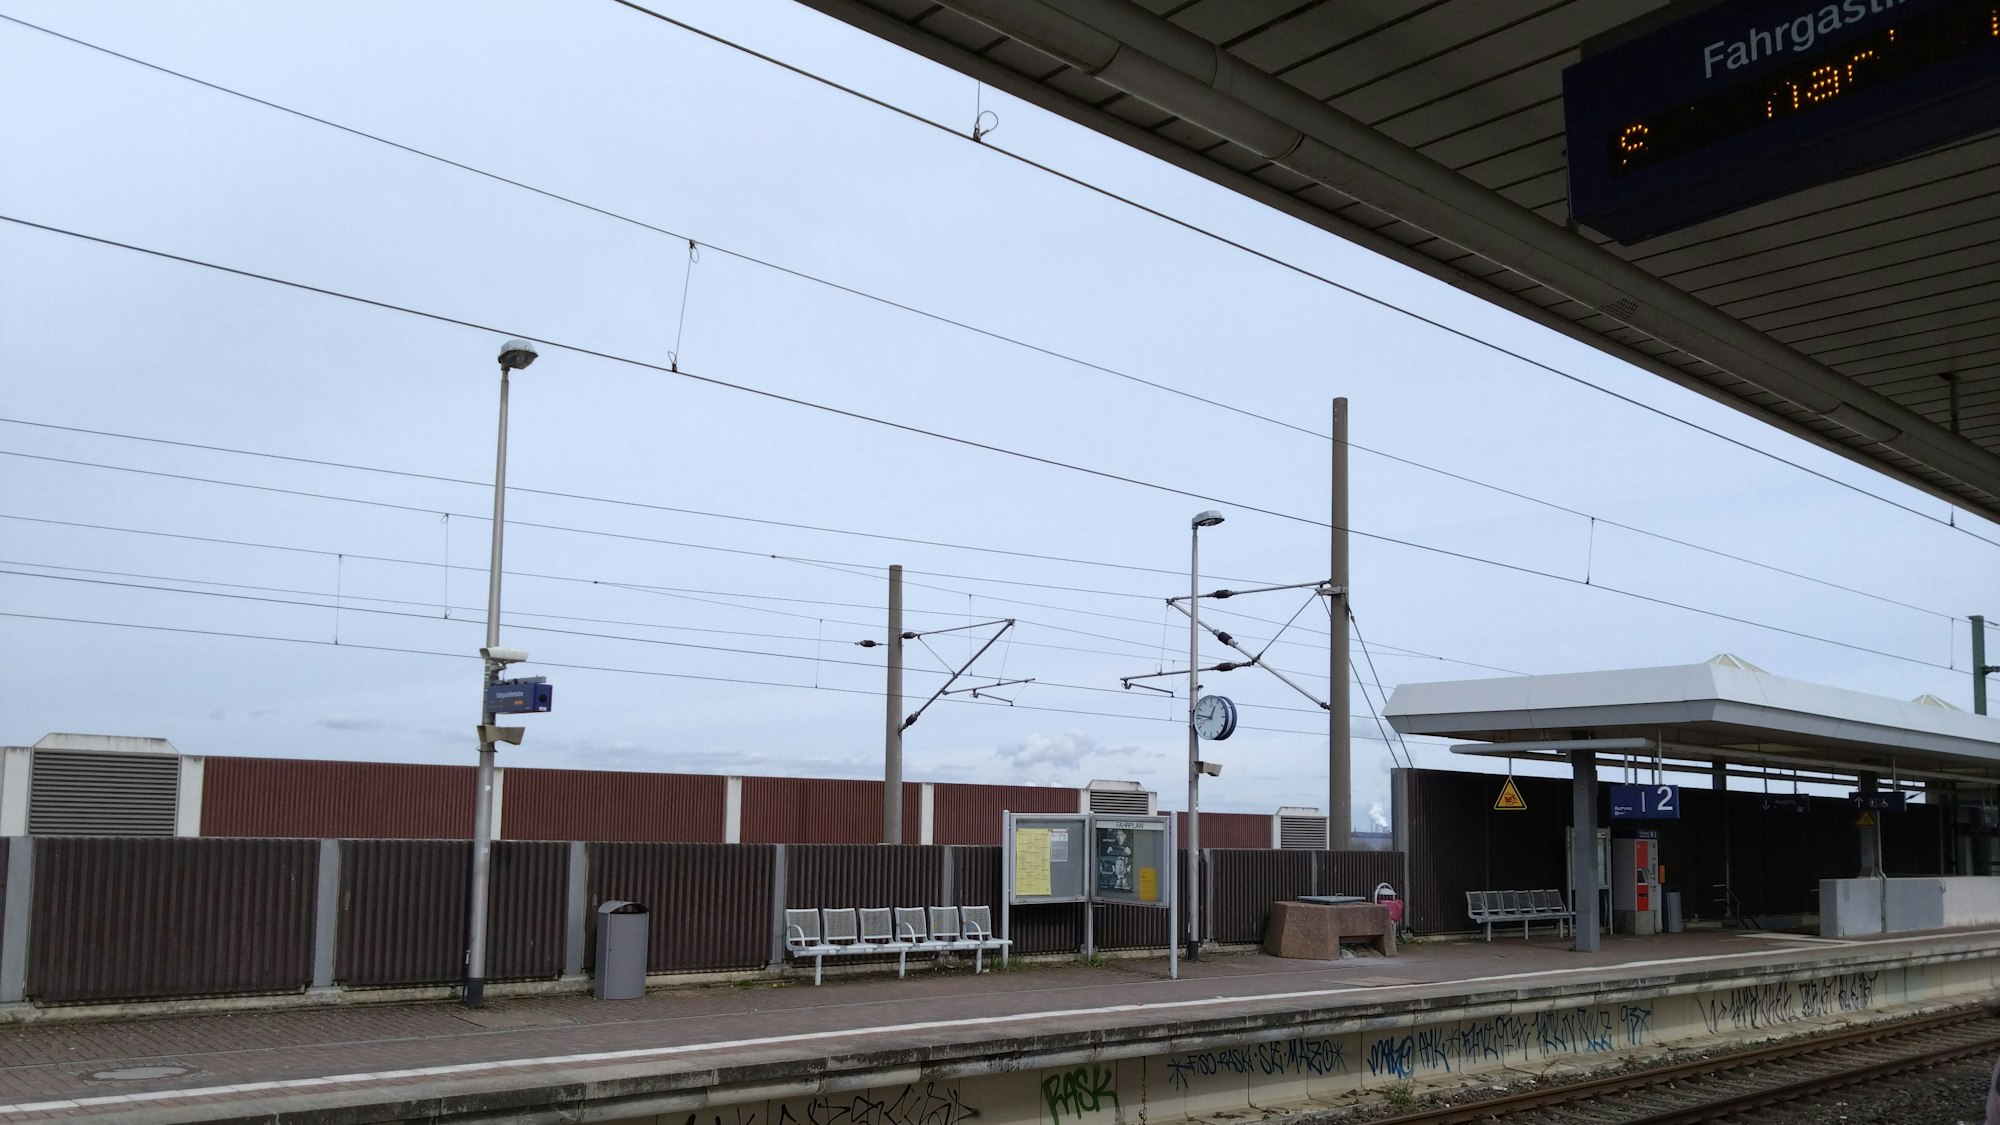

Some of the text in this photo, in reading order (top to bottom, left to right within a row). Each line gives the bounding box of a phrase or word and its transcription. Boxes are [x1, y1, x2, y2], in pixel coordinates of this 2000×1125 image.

[1657, 785, 1673, 811] 2
[1115, 821, 1144, 829] FAHRPLAN
[1042, 1062, 1122, 1125] RASK
